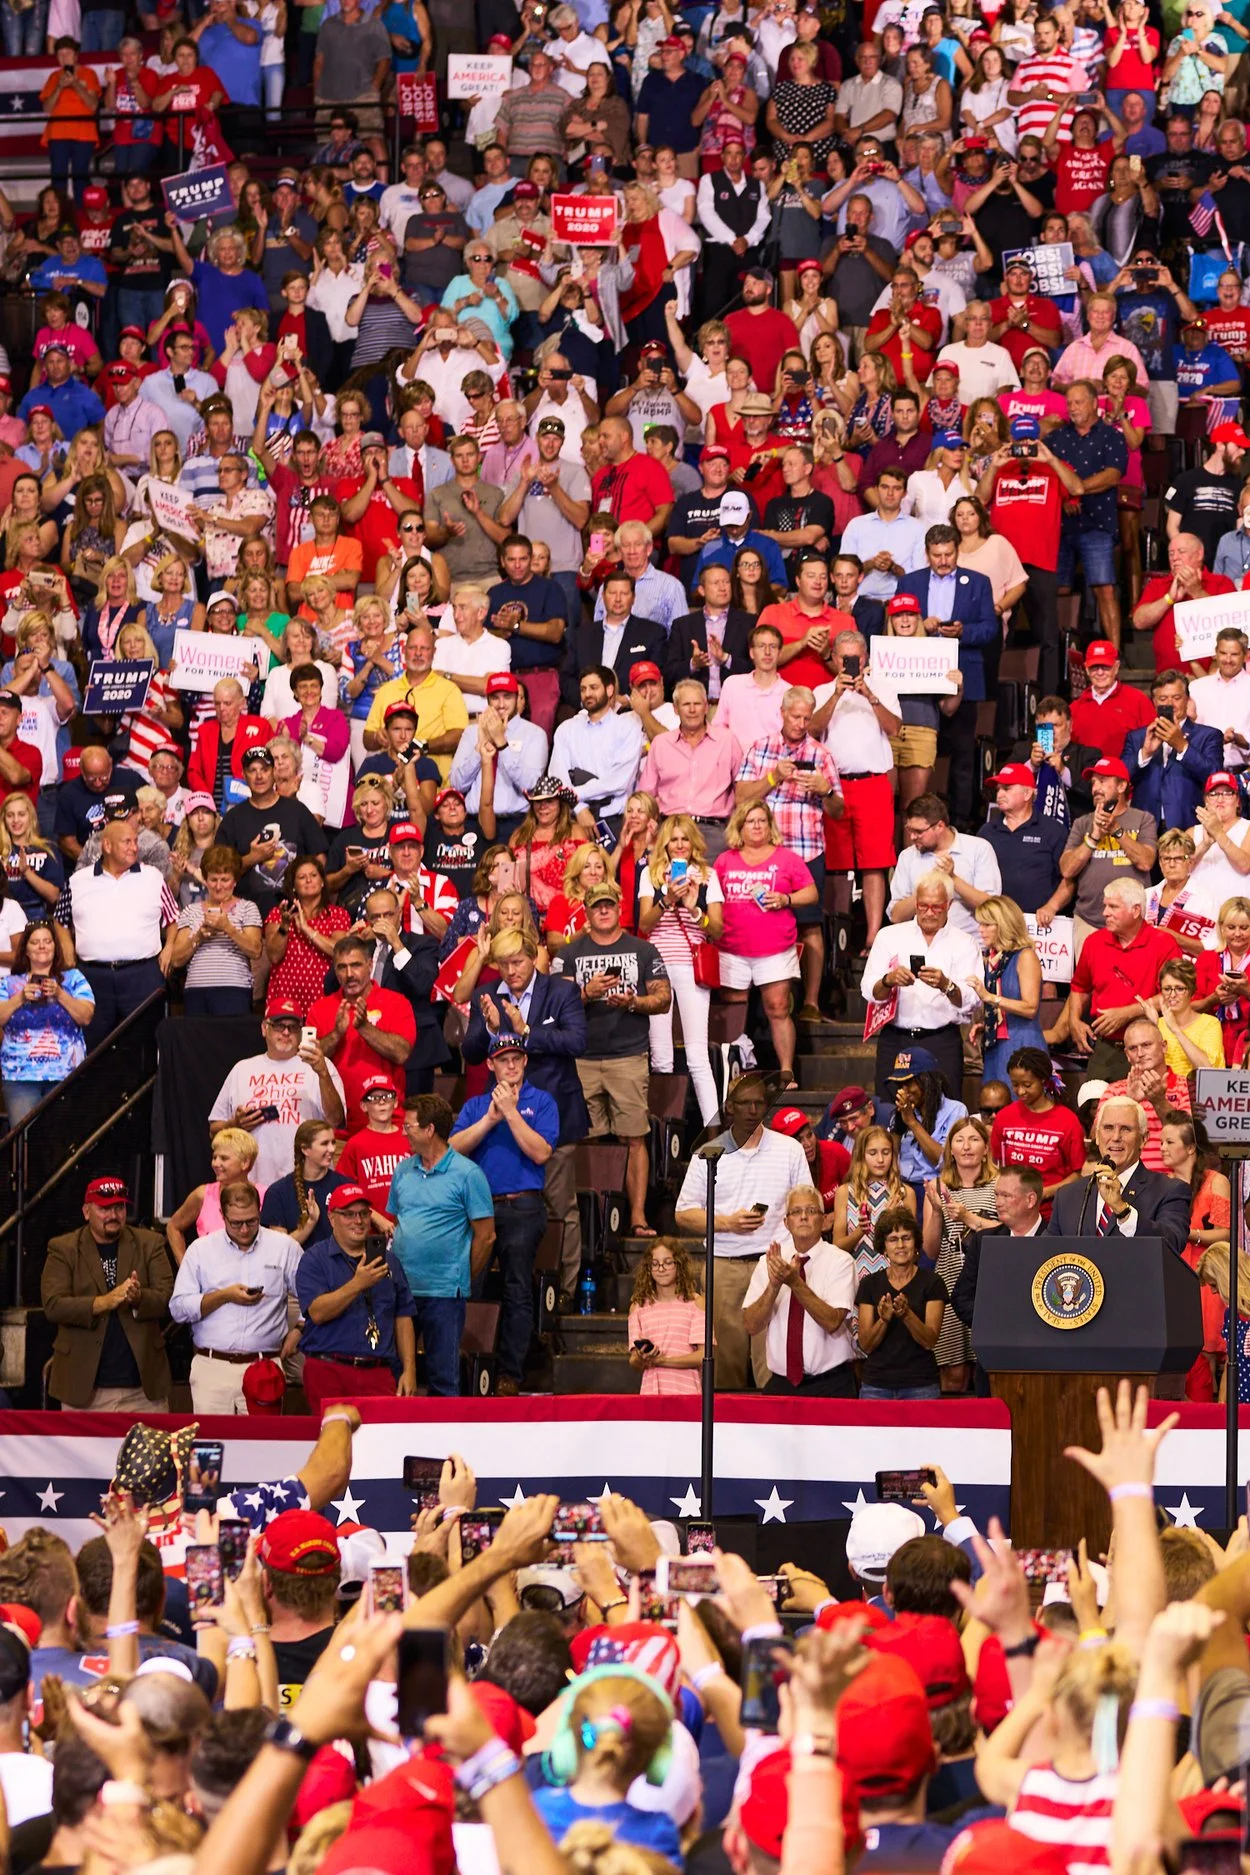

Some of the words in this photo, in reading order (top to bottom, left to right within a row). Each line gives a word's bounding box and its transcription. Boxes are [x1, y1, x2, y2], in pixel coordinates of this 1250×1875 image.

[453, 72, 506, 81] AMERICA
[460, 83, 500, 92] GREAT!
[169, 177, 225, 201] TRUMP
[555, 205, 614, 218] TRUMP
[567, 223, 600, 233] 2020
[1018, 248, 1061, 263] OBS!
[1031, 262, 1063, 278] OBS!
[1029, 276, 1065, 293] OBS!
[1177, 372, 1204, 385] 2020
[687, 507, 720, 519] TRUM
[1192, 633, 1212, 642] FOR
[179, 645, 243, 669] Women
[877, 651, 951, 670] Women
[93, 671, 149, 685] TRUMP
[185, 667, 203, 675] FOR
[207, 668, 239, 679] TRUMP
[910, 671, 944, 679] TRUMP
[102, 689, 132, 701] 2020
[1044, 785, 1055, 817] 202
[729, 871, 773, 881] WOMEN
[1027, 924, 1052, 937] EEP
[1035, 942, 1068, 956] RICA
[575, 953, 638, 970] VETERANS
[249, 1072, 305, 1087] MAKE
[253, 1085, 297, 1101] Ohio
[246, 1098, 302, 1113] GREAT
[278, 1110, 301, 1125] AIN
[1006, 1131, 1060, 1145] TRUMP
[1011, 1152, 1025, 1162] 20
[1029, 1153, 1044, 1164] 20
[1035, 1256, 1068, 1290] PRESIDENT
[1087, 1265, 1102, 1296] UNITED
[1042, 1310, 1062, 1326] SEAL
[1073, 1302, 1098, 1326] STATES
